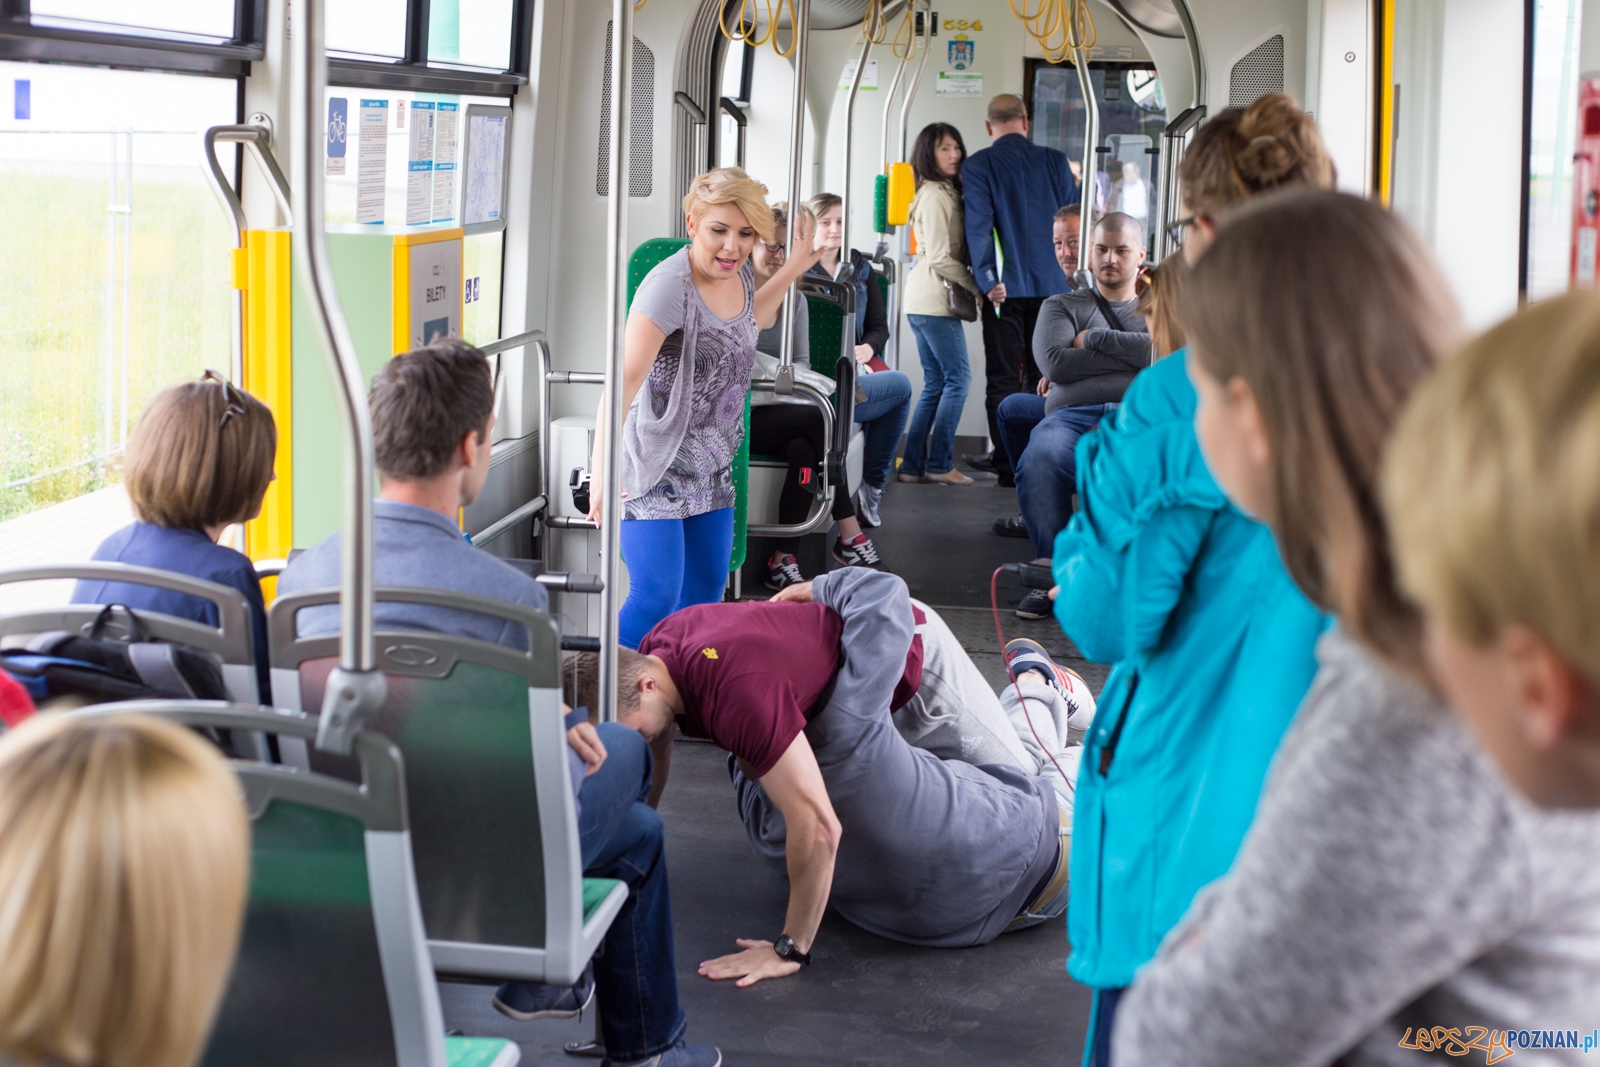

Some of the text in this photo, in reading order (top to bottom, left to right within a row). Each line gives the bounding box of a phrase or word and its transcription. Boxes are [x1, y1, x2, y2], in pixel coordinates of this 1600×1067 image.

[943, 19, 983, 31] 534
[426, 285, 447, 303] BILETY
[702, 647, 719, 660] 4F
